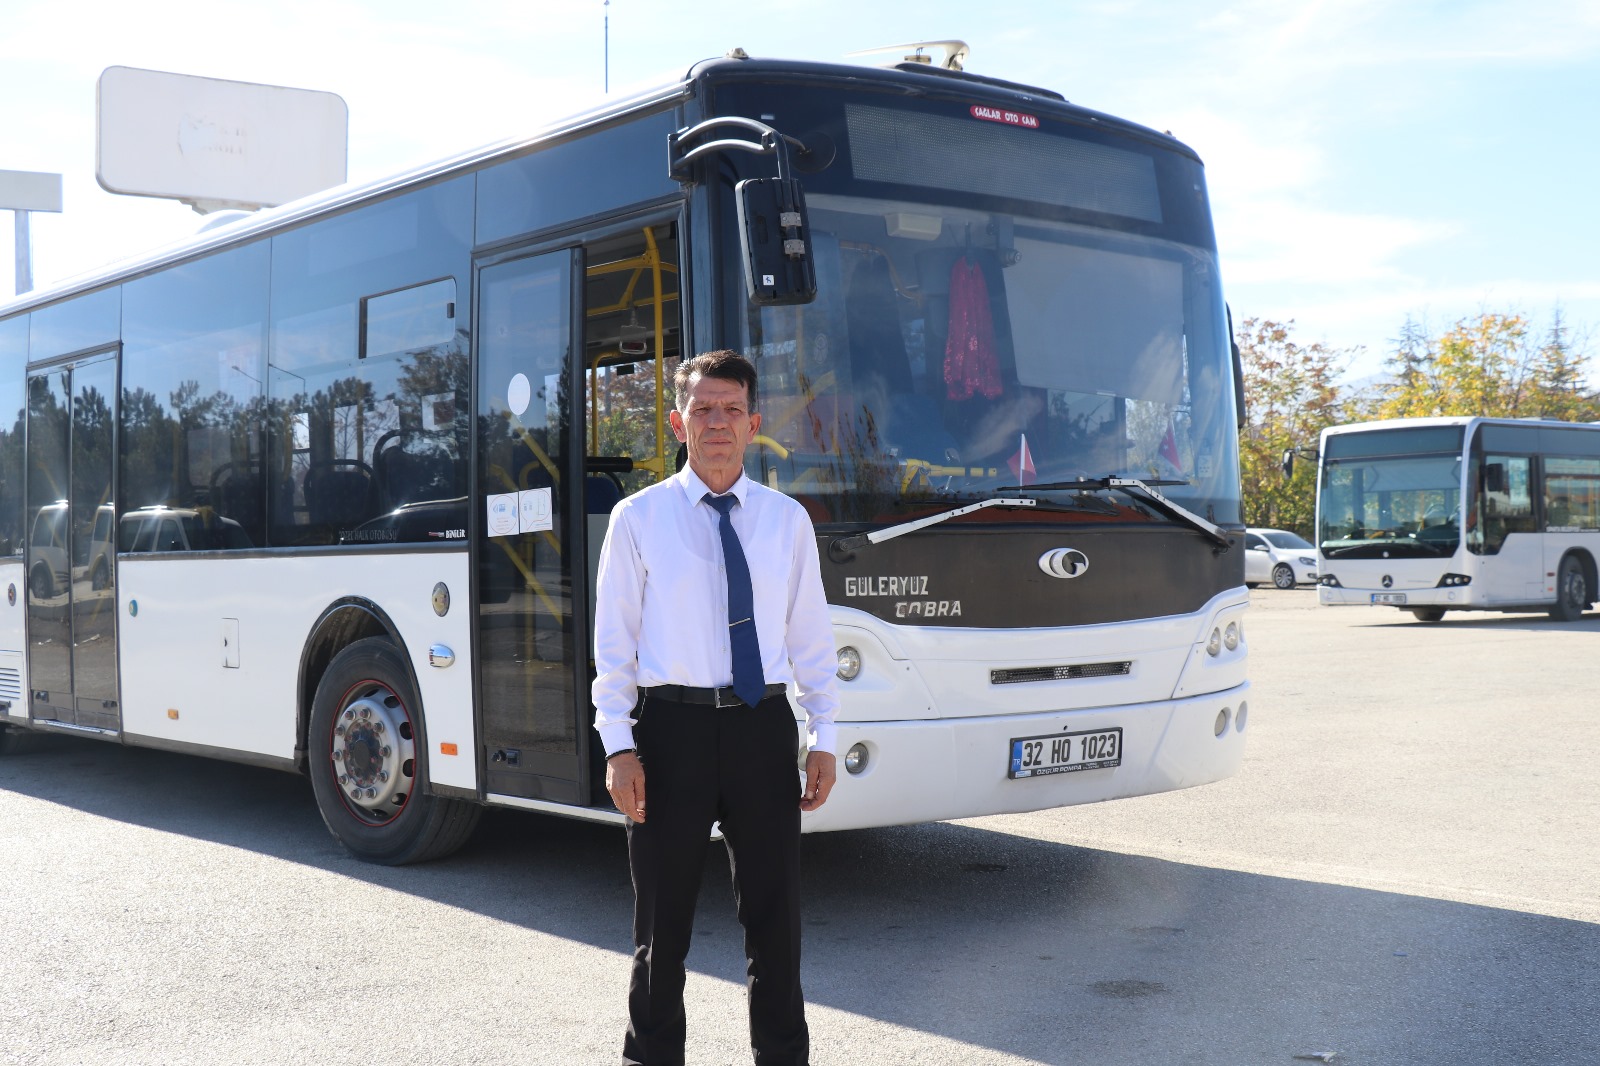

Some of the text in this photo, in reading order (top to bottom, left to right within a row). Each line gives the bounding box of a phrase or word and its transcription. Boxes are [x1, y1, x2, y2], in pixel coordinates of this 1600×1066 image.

[1004, 112, 1019, 123] OTO
[845, 576, 929, 597] GÜLERYÜZ
[895, 600, 962, 618] COBRA
[1022, 733, 1117, 767] 32 HO 1023
[1013, 758, 1021, 766] TR
